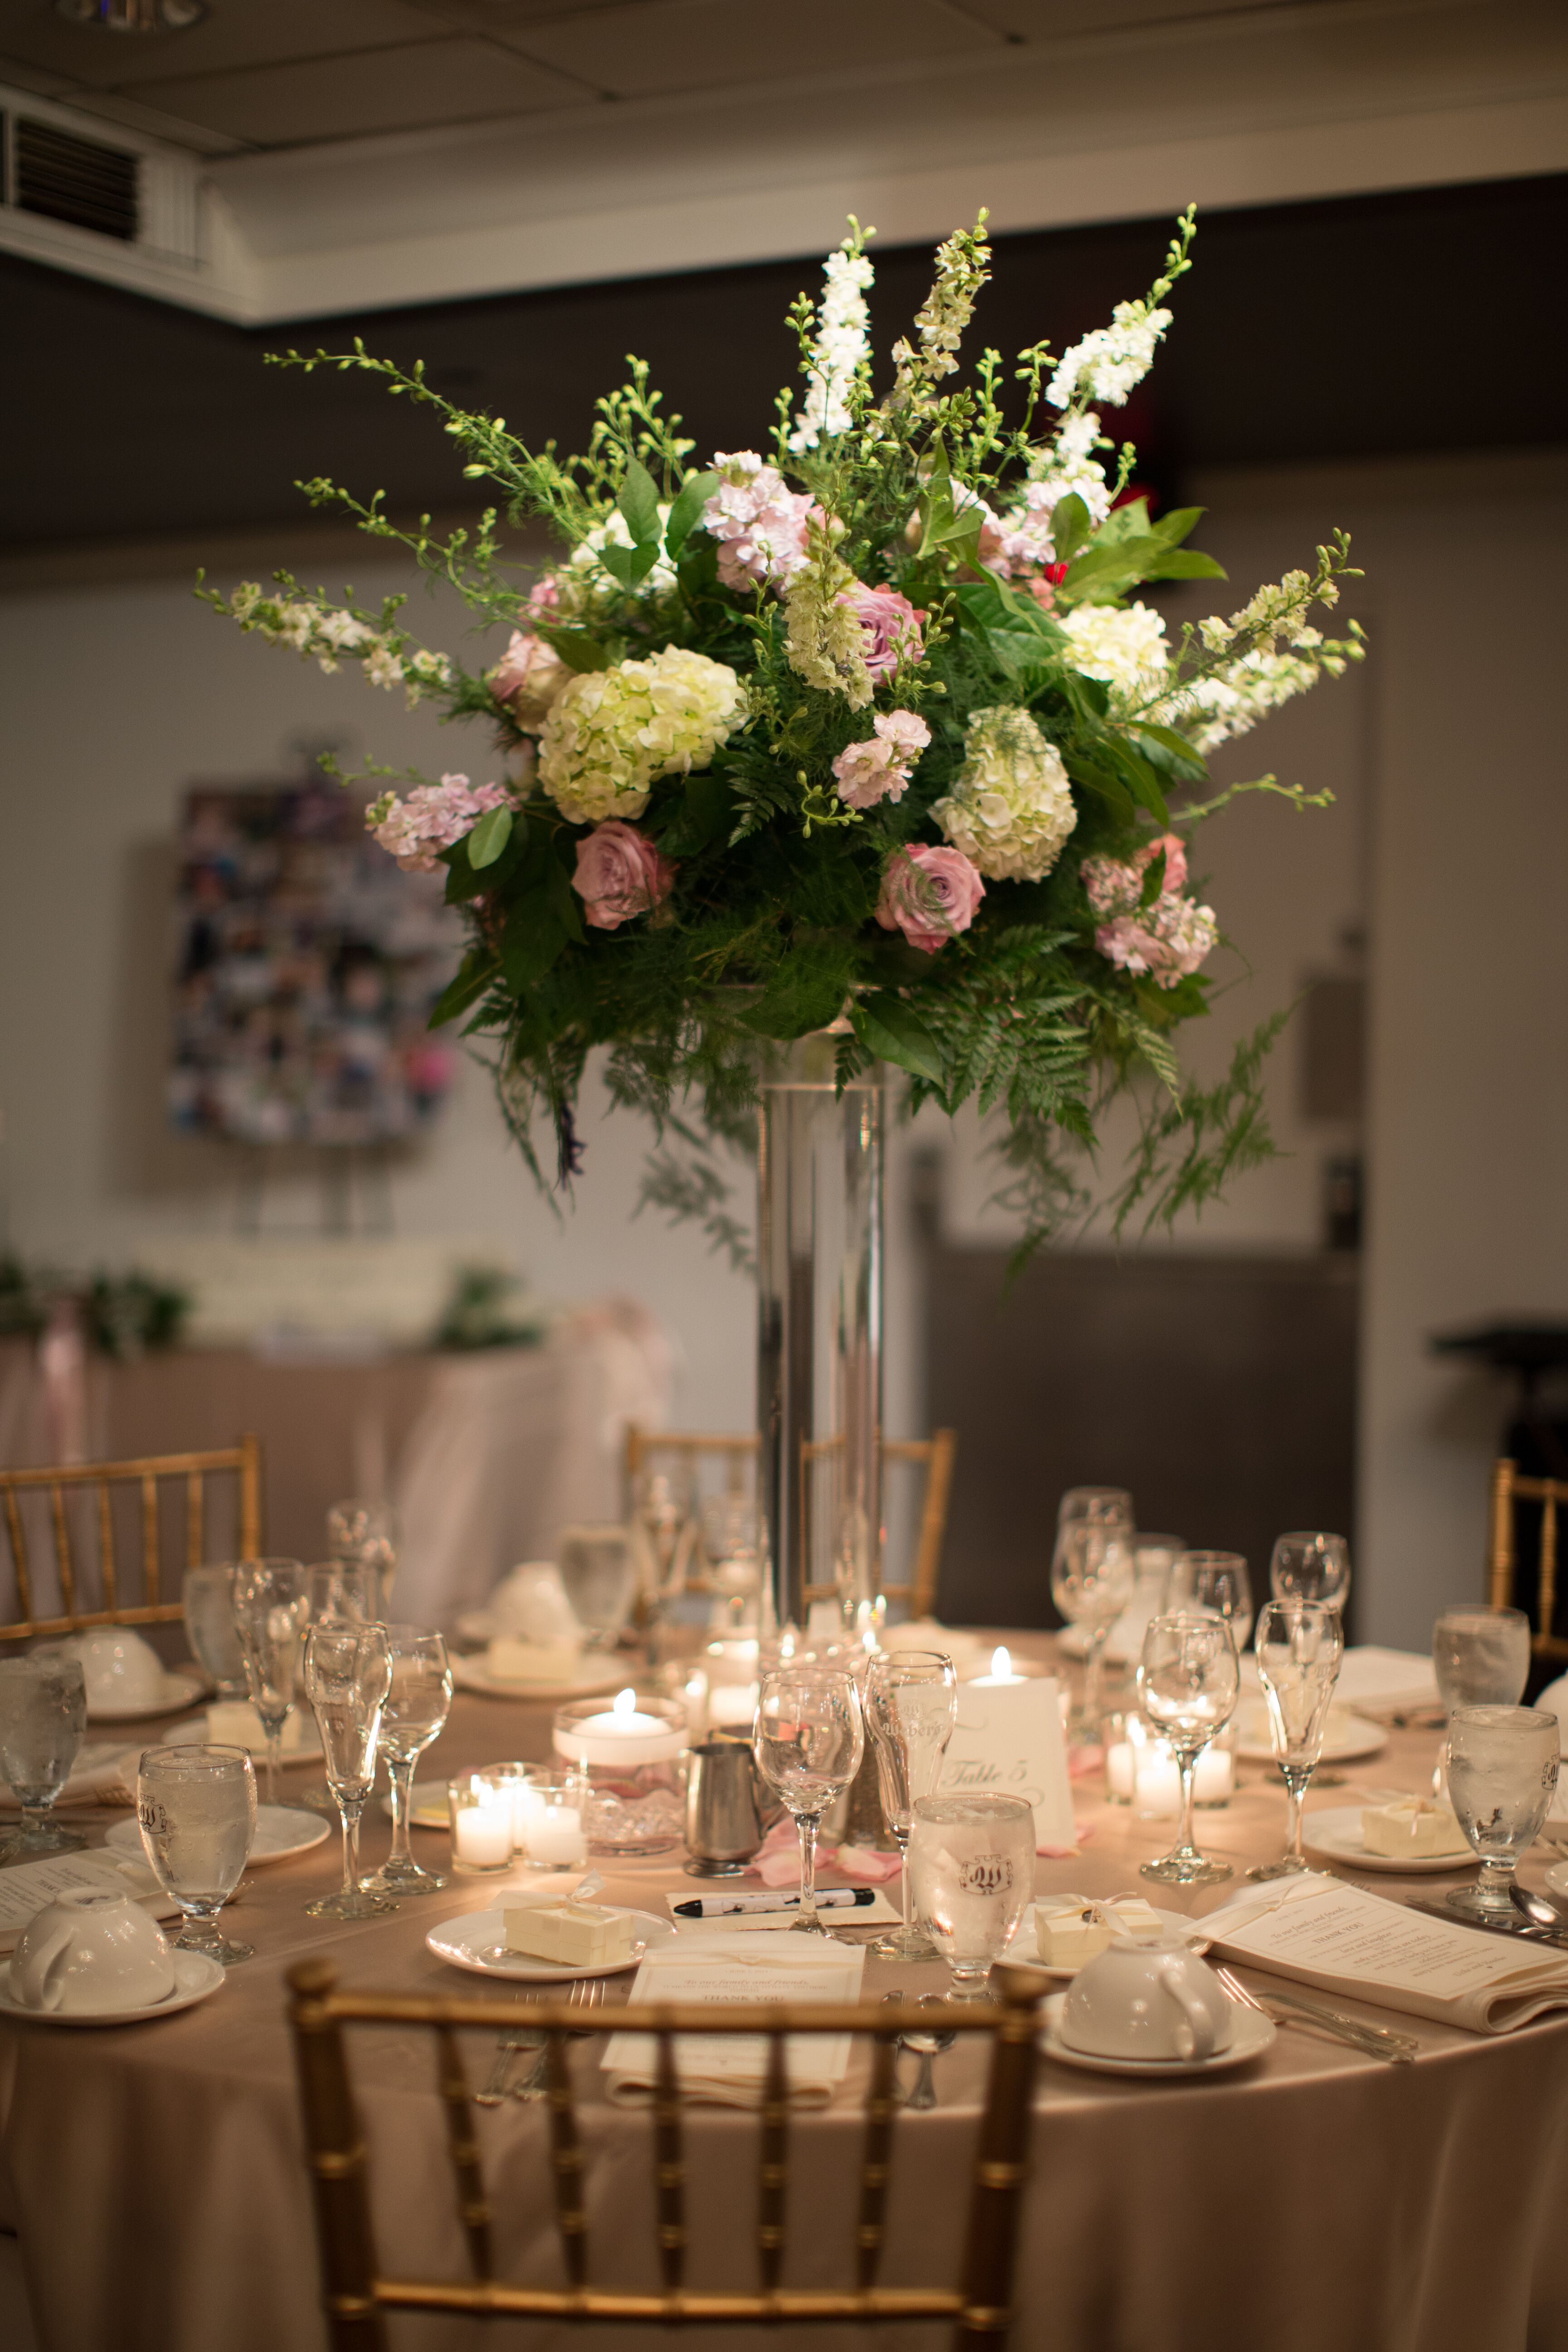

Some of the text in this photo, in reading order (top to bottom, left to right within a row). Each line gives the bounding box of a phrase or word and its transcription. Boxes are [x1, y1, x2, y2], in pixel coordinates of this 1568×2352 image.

[941, 1759, 1002, 1787] Table
[1291, 1921, 1314, 1932] family
[1323, 1906, 1349, 1919] friends,
[1312, 1922, 1364, 1944] THANK YOU
